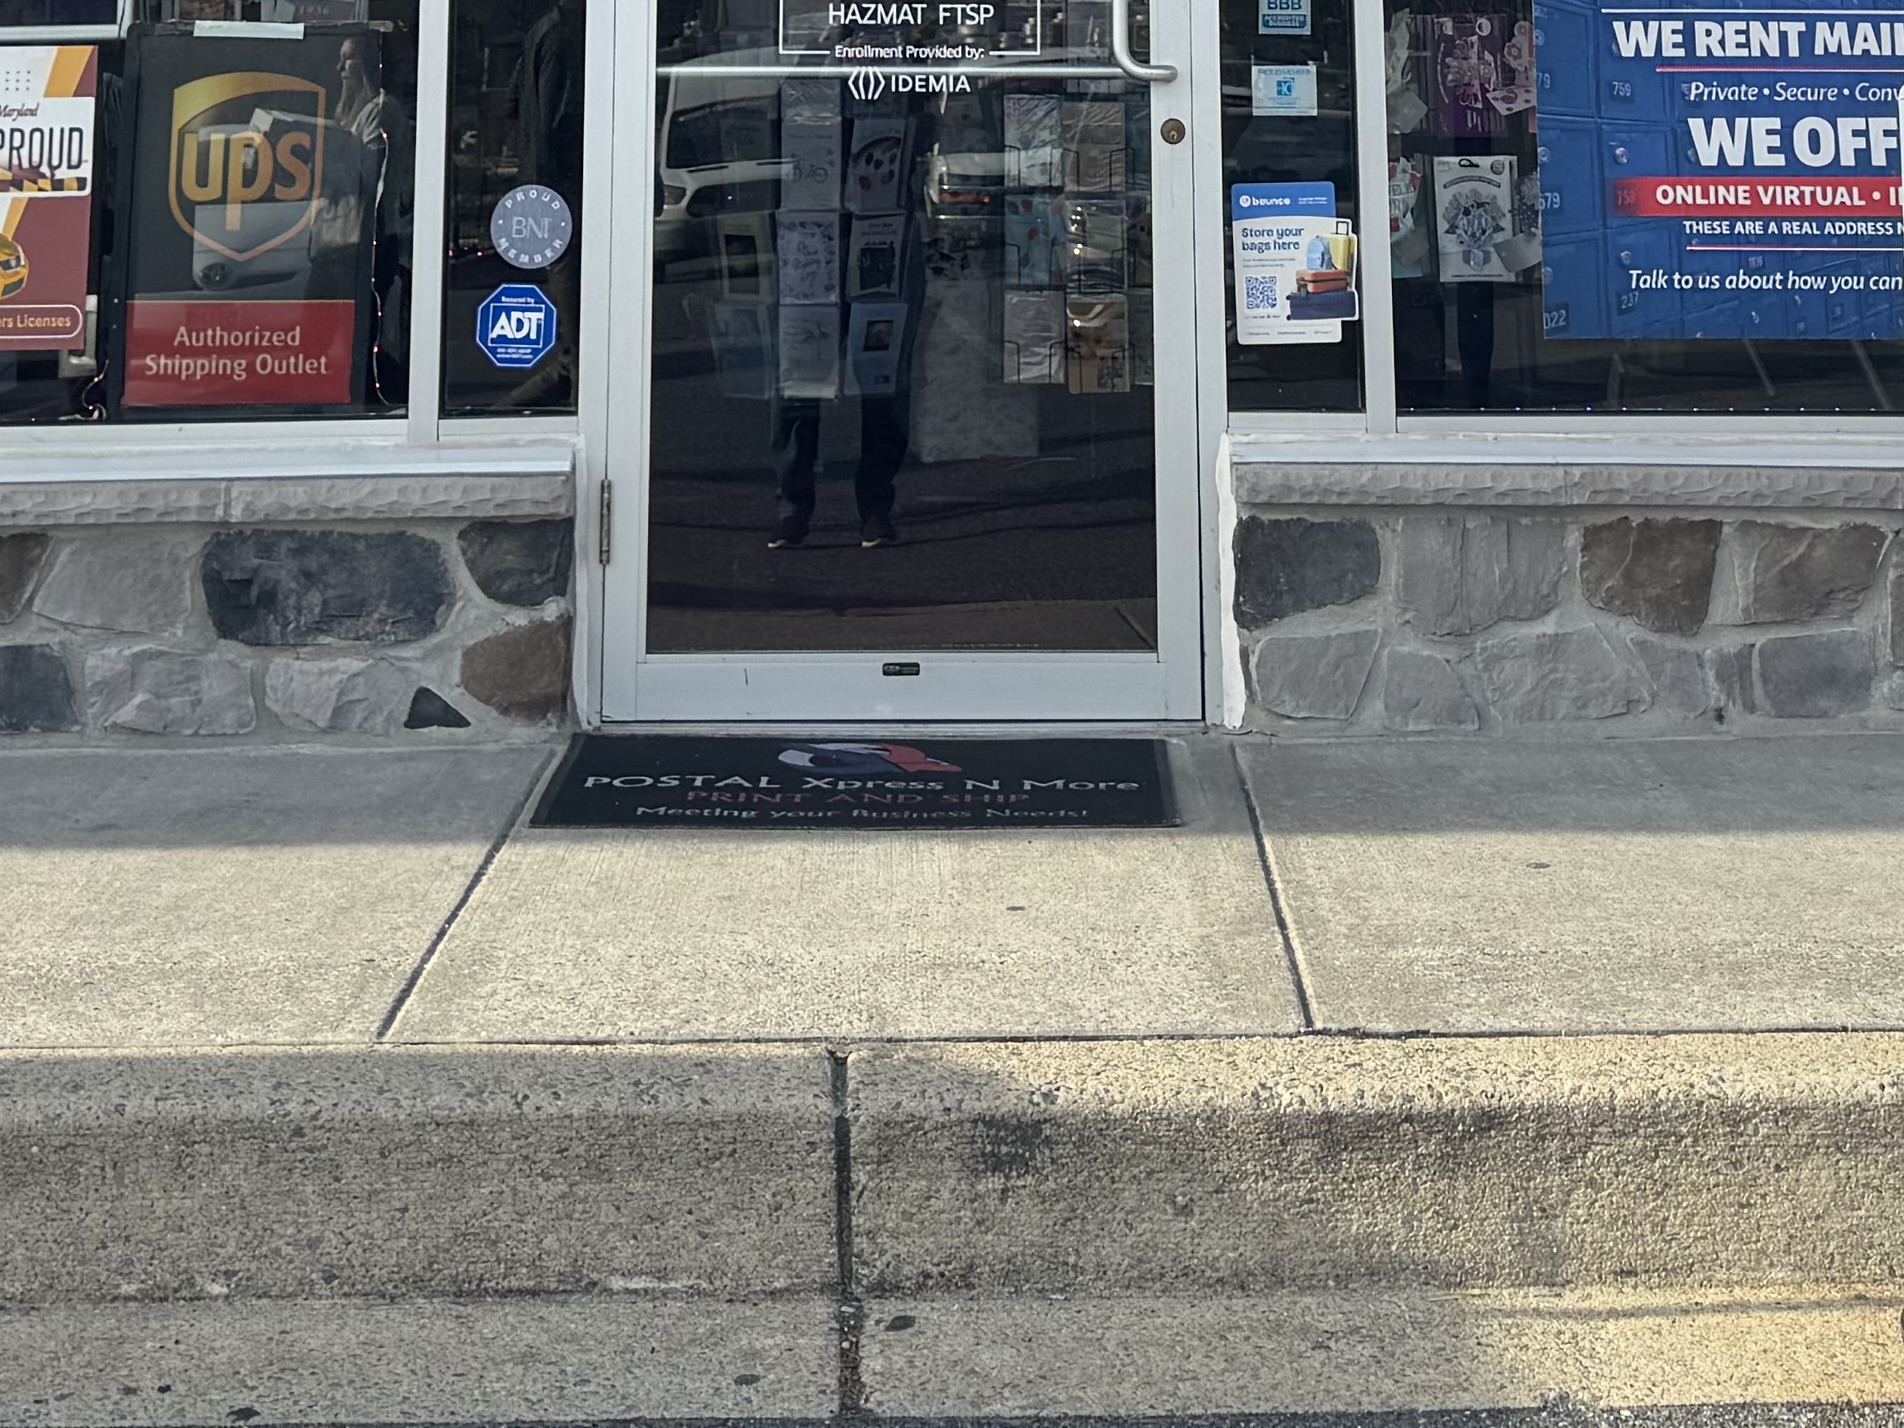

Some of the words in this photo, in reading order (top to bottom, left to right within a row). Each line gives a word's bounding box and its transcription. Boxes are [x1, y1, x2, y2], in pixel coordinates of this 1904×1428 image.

[828, 4, 927, 26] HAZMAT
[938, 4, 995, 26] FTSP
[1612, 20, 1685, 58] WE
[1694, 21, 1806, 58] RENT
[891, 74, 971, 93] IDEMIA
[1689, 82, 1759, 102] Private
[1773, 83, 1838, 102] Secure
[1687, 117, 1788, 168] WE
[182, 130, 313, 232] ups
[1655, 184, 1751, 207] ONLINE
[1757, 184, 1867, 206] VIRTUAL
[1683, 220, 1734, 236] THESE
[1737, 220, 1764, 236] ARE
[1767, 220, 1779, 236] A
[1782, 220, 1822, 236] REAL
[1824, 220, 1893, 236] ADDRESS
[1629, 270, 1667, 289] Talk
[1672, 271, 1694, 289] to
[1698, 276, 1719, 289] us
[1725, 270, 1783, 289] about
[1787, 270, 1826, 289] how
[1829, 276, 1865, 294] you
[1869, 277, 1903, 290] can
[16, 312, 72, 327] Licenses
[491, 311, 544, 339] ADT
[173, 326, 301, 347] Authorized
[144, 353, 248, 381] Shipping
[256, 354, 328, 376] Outlet
